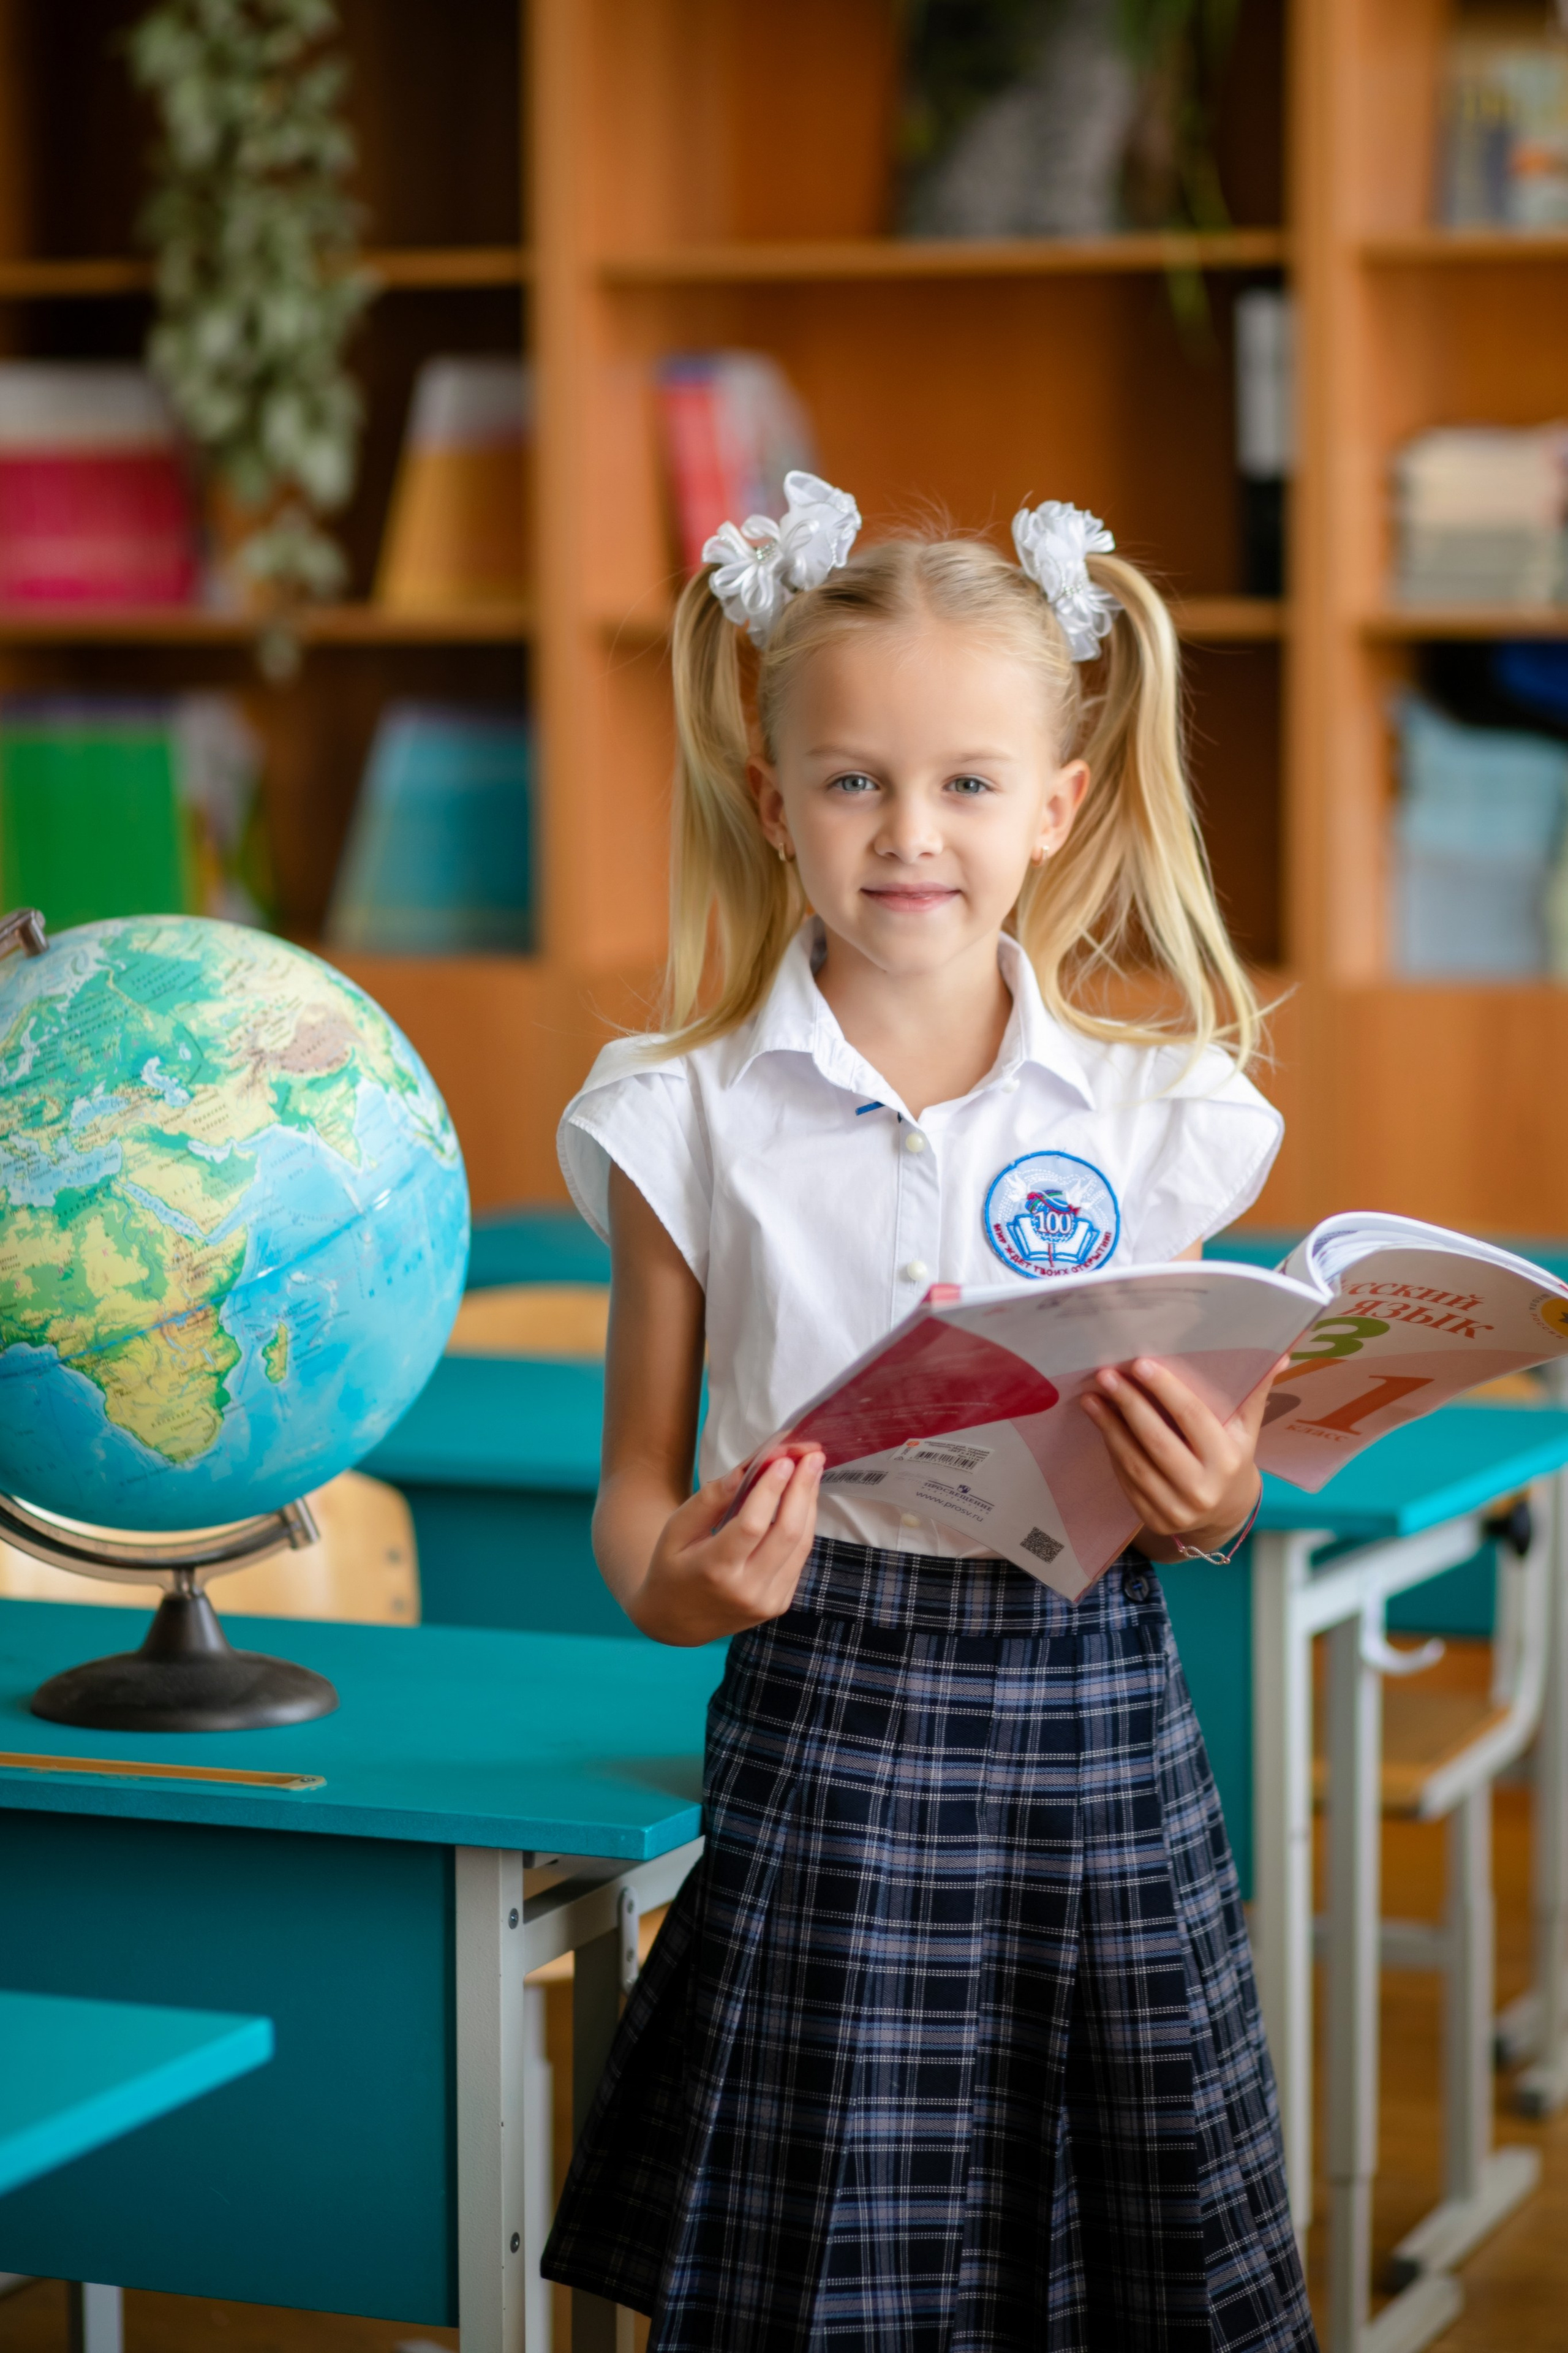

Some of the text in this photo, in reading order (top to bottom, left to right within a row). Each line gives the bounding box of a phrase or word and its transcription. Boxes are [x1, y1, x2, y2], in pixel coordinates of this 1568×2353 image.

[1034, 1211, 1072, 1234] 100
[993, 1223, 1006, 1244] МИР
[1033, 1264, 1069, 1277] ТВОИХ
[1336, 1300, 1494, 1339] ЯЗЫК
[1295, 1375, 1435, 1436] 1
[916, 1492, 984, 1522] www.prosv.ru
[924, 1482, 993, 1512] ПРОСВЕЩЕНИЕ
